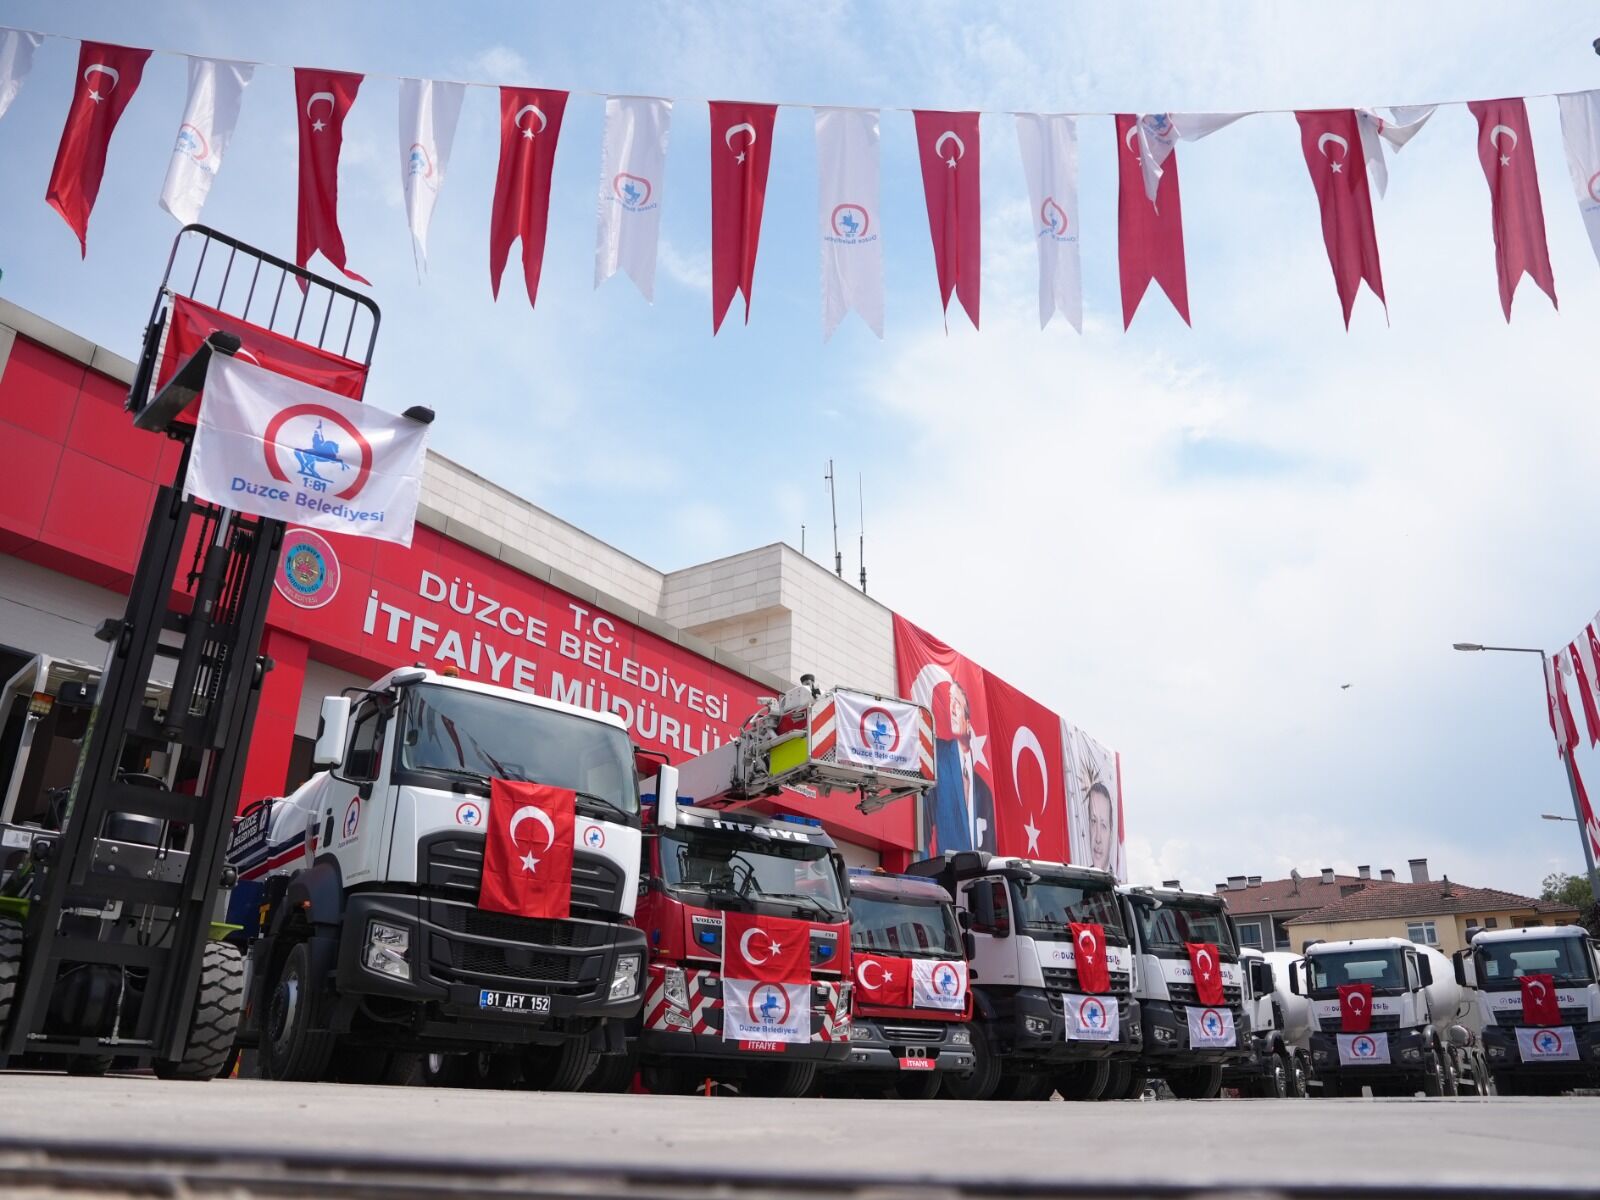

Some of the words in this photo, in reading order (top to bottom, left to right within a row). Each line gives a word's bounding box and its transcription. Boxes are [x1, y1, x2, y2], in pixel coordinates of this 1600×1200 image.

[231, 477, 290, 502] Düzce
[295, 492, 385, 522] Belediyesi
[302, 477, 327, 493] 1:81
[418, 569, 548, 648] DÜZCE
[559, 630, 728, 723] BELEDİYESİ
[568, 603, 620, 649] T.C.
[362, 589, 537, 696] İTFAİYE
[550, 670, 740, 757] MÜDÜRLÜ
[695, 916, 722, 925] VOLVO
[487, 992, 500, 1007] 81
[505, 994, 526, 1009] AFY
[531, 996, 549, 1011] 152
